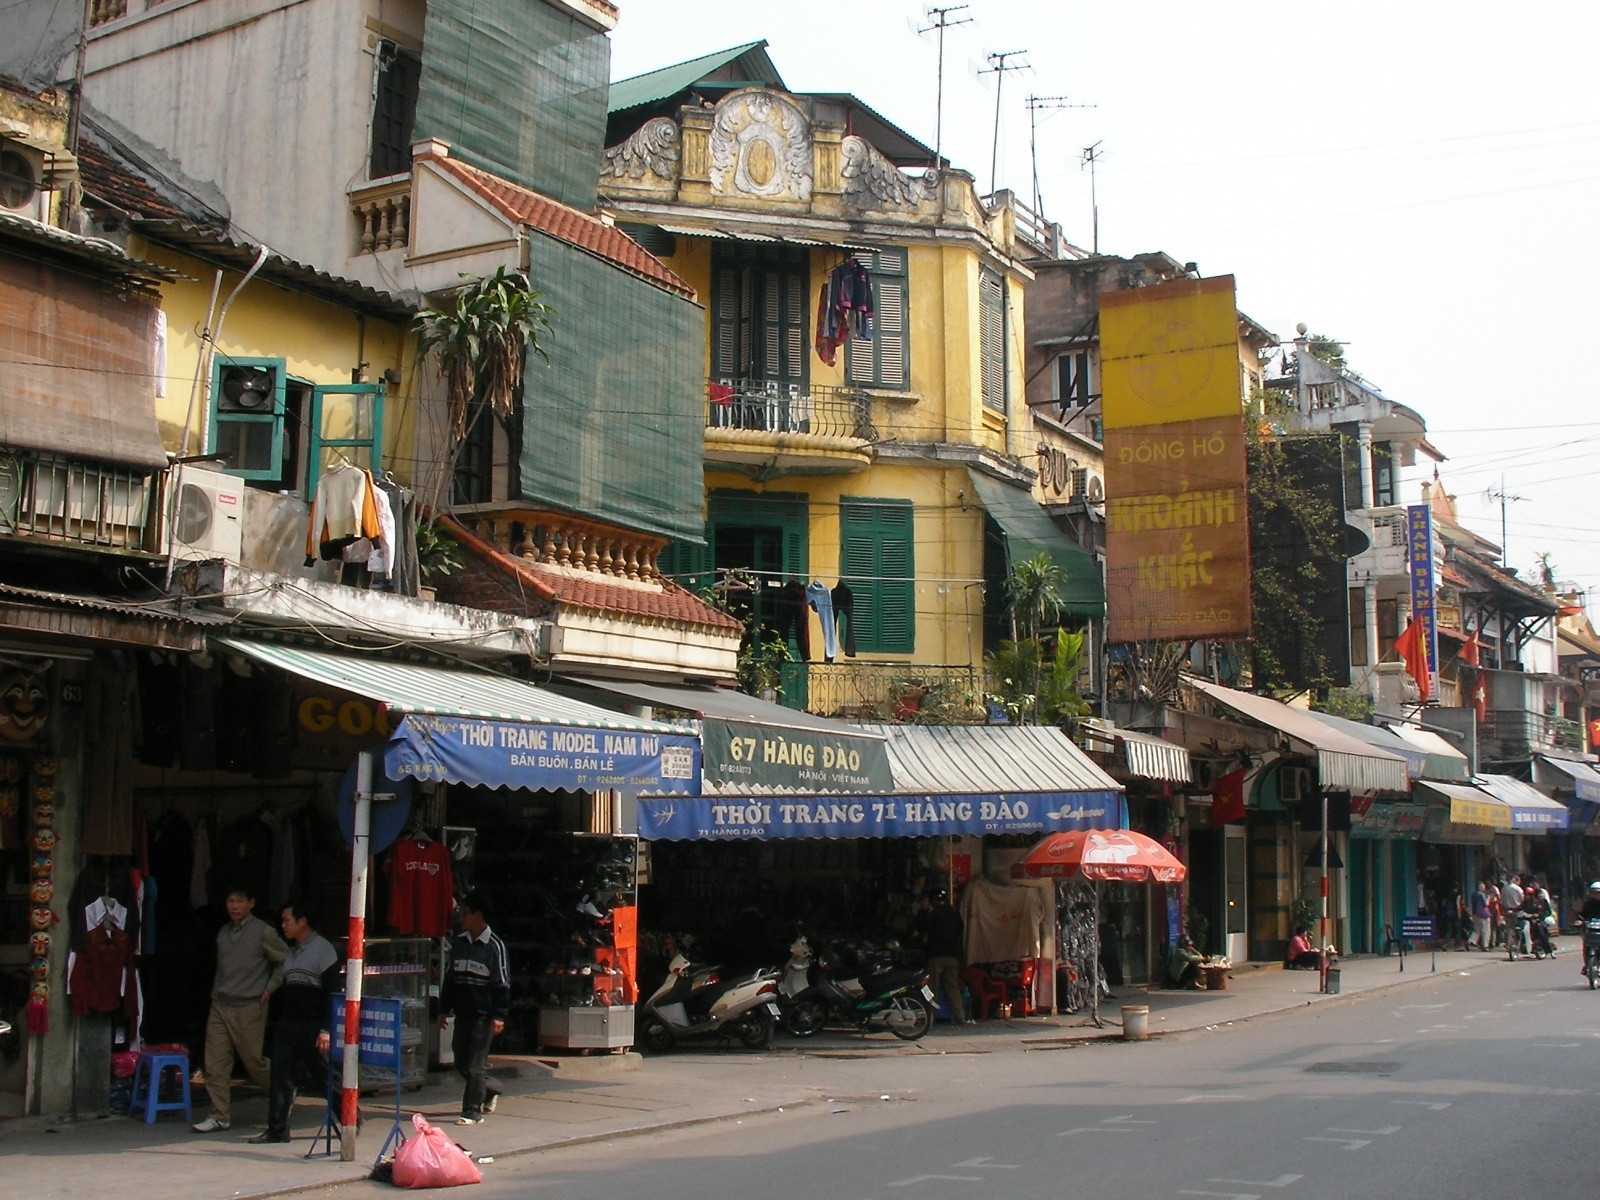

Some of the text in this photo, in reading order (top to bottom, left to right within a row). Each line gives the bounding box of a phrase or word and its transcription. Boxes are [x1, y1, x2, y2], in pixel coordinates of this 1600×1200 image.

[1412, 510, 1428, 562] THANH
[64, 685, 82, 702] 63
[459, 721, 495, 747] THỜI
[499, 727, 547, 751] TRANG
[552, 731, 600, 754] MODEL
[604, 734, 637, 756] NAM
[641, 733, 660, 757] NỮ
[510, 753, 535, 767] BÁN
[574, 756, 598, 770] BÁN
[730, 736, 861, 772] 67 HÀNG ĐÀO
[850, 776, 870, 785] NAM
[712, 798, 772, 825] THỜI
[779, 803, 865, 825] TRANG
[871, 803, 897, 823] 71
[904, 796, 973, 822] HÀNG
[979, 794, 1030, 821] ĐÀO
[698, 829, 709, 837] 71
